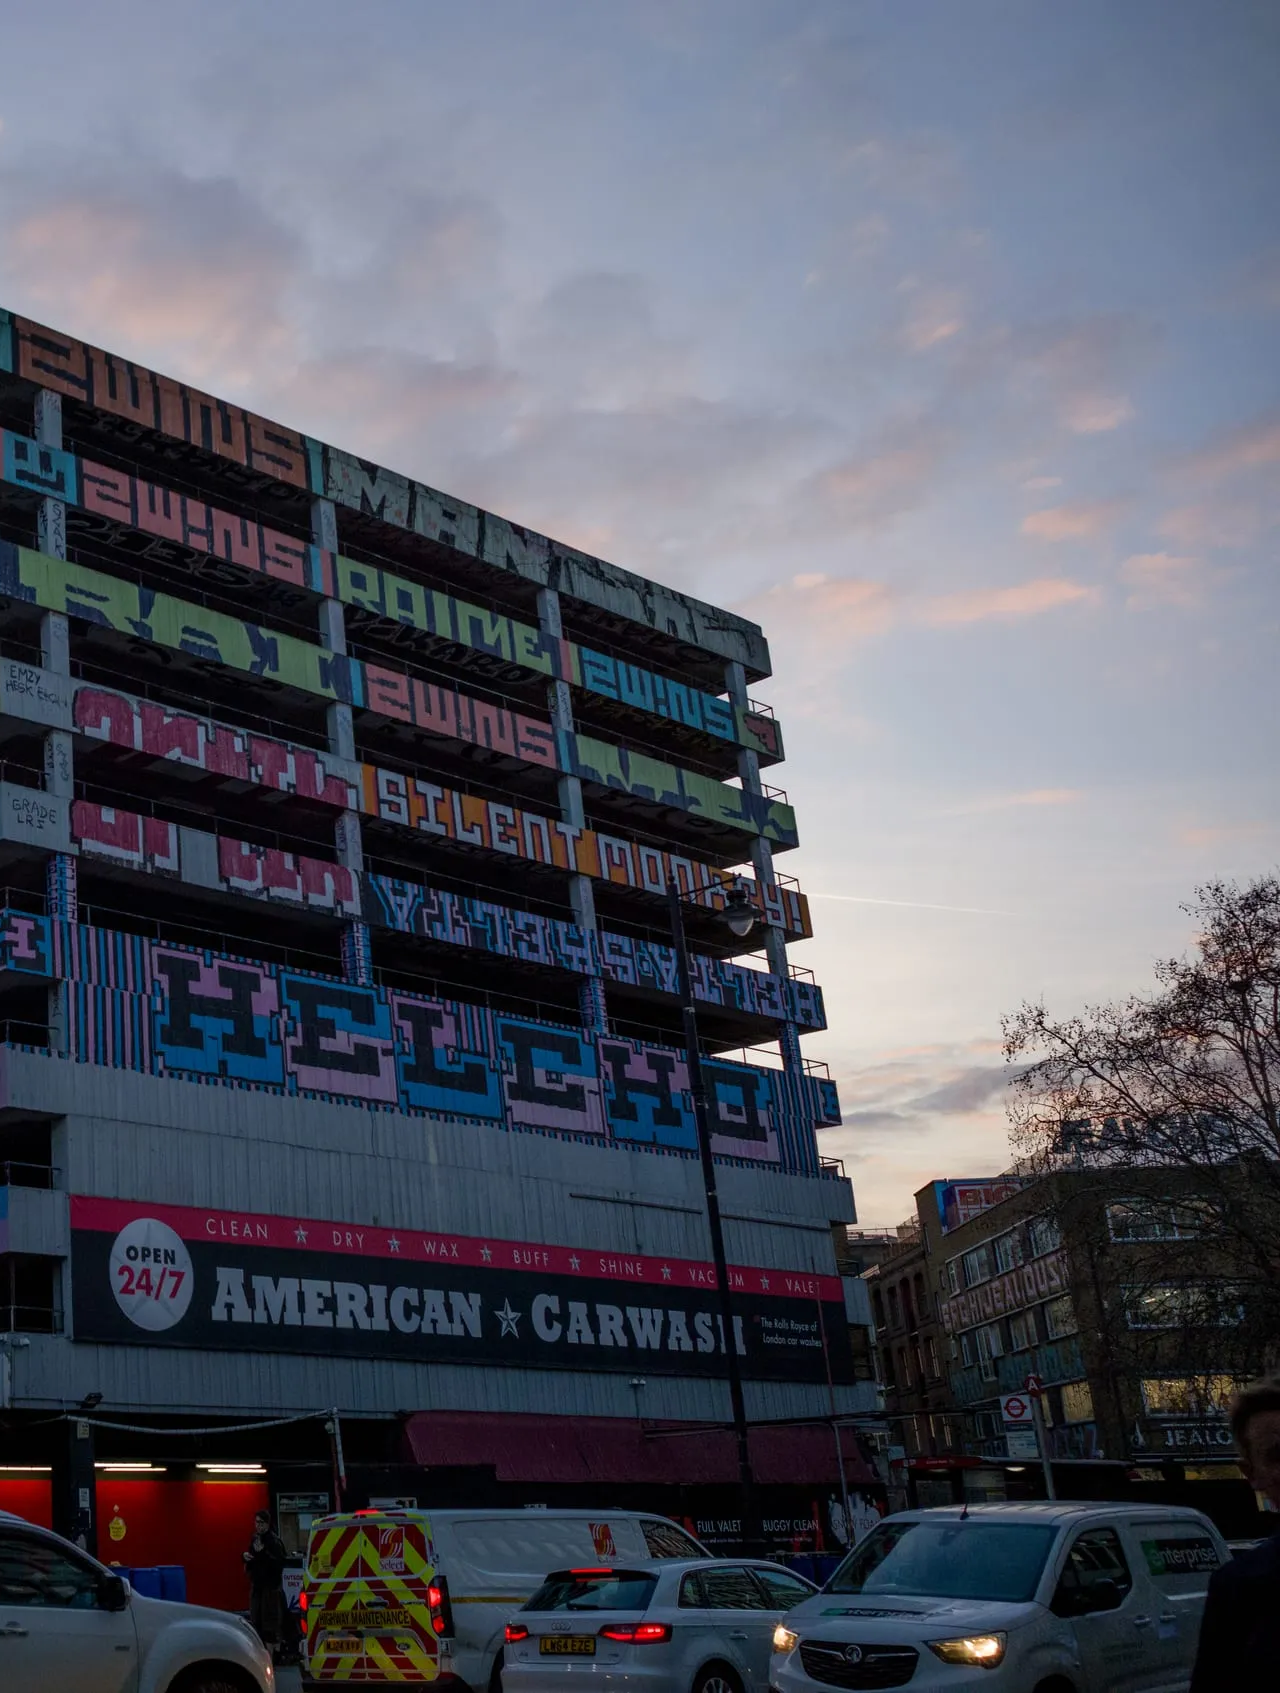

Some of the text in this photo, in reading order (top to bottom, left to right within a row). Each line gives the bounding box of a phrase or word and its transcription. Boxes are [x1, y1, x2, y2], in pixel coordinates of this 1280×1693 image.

[126, 1245, 176, 1265] OPEN
[206, 1218, 269, 1240] CLEAN
[333, 1230, 364, 1249] DRY
[423, 1239, 460, 1259] WAX
[513, 1249, 550, 1268] BUFF
[599, 1258, 644, 1277] SHINE
[689, 1267, 745, 1287] VACUM
[118, 1266, 185, 1301] 24/7
[211, 1267, 747, 1357] AMERICAN CARWASH
[760, 1316, 774, 1329] The
[774, 1318, 789, 1330] Rolls
[763, 1332, 786, 1345] London
[1028, 1379, 1039, 1390] A
[697, 1519, 741, 1533] FULL VALET
[762, 1519, 819, 1532] BUGGY CLEAN
[1152, 1544, 1218, 1568] enterprise
[379, 1558, 404, 1571] Select
[320, 1610, 410, 1626] HIGHWAY MAINTENANCE
